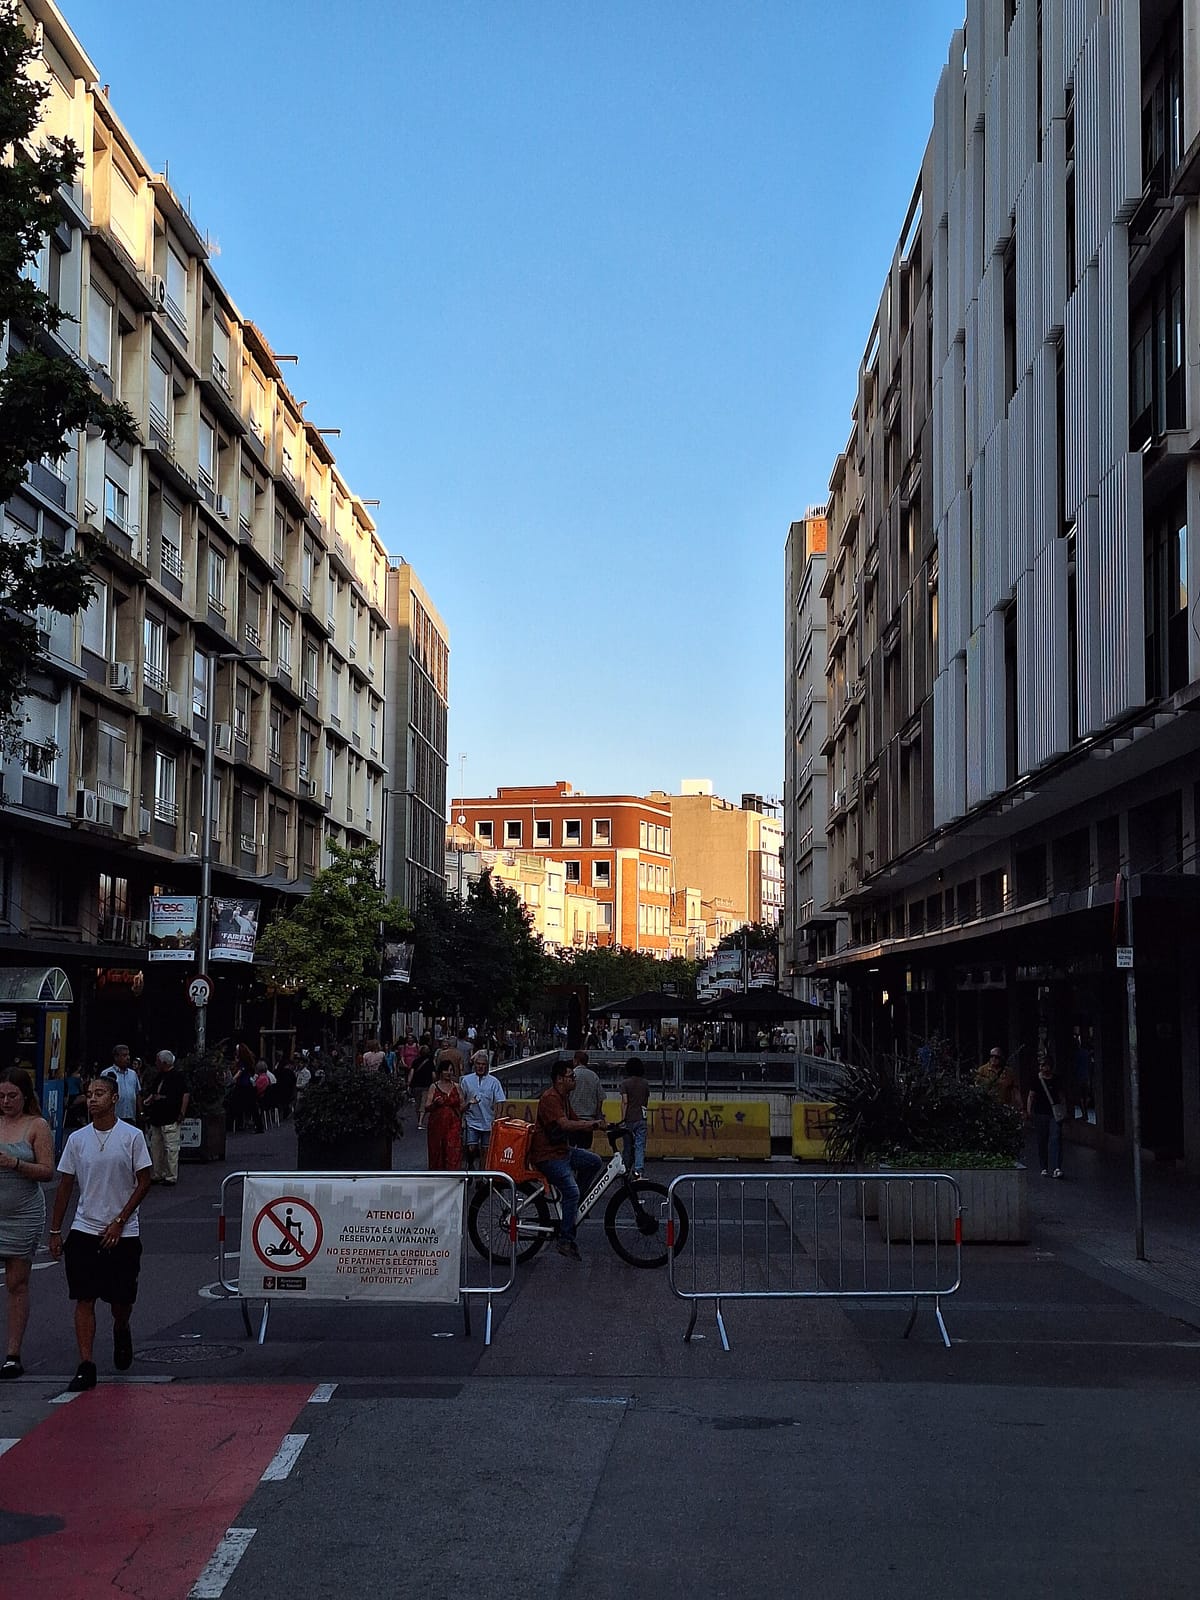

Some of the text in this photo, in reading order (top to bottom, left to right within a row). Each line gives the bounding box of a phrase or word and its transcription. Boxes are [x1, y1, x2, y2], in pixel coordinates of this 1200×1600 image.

[192, 985, 208, 997] 20
[585, 1175, 609, 1206] zoomo
[342, 1225, 436, 1236] AQUESTA ÉS UNA ZONA
[339, 1234, 439, 1245] RESERVADA A VIANANTS
[326, 1247, 450, 1258] NO ES PERMET LA CIRCULACIÓ
[338, 1257, 349, 1265] DE
[351, 1257, 391, 1266] PATINETS
[336, 1266, 440, 1277] NI DE CAP ALTRE VEHICLE
[360, 1275, 415, 1285] MOTORITZAT
